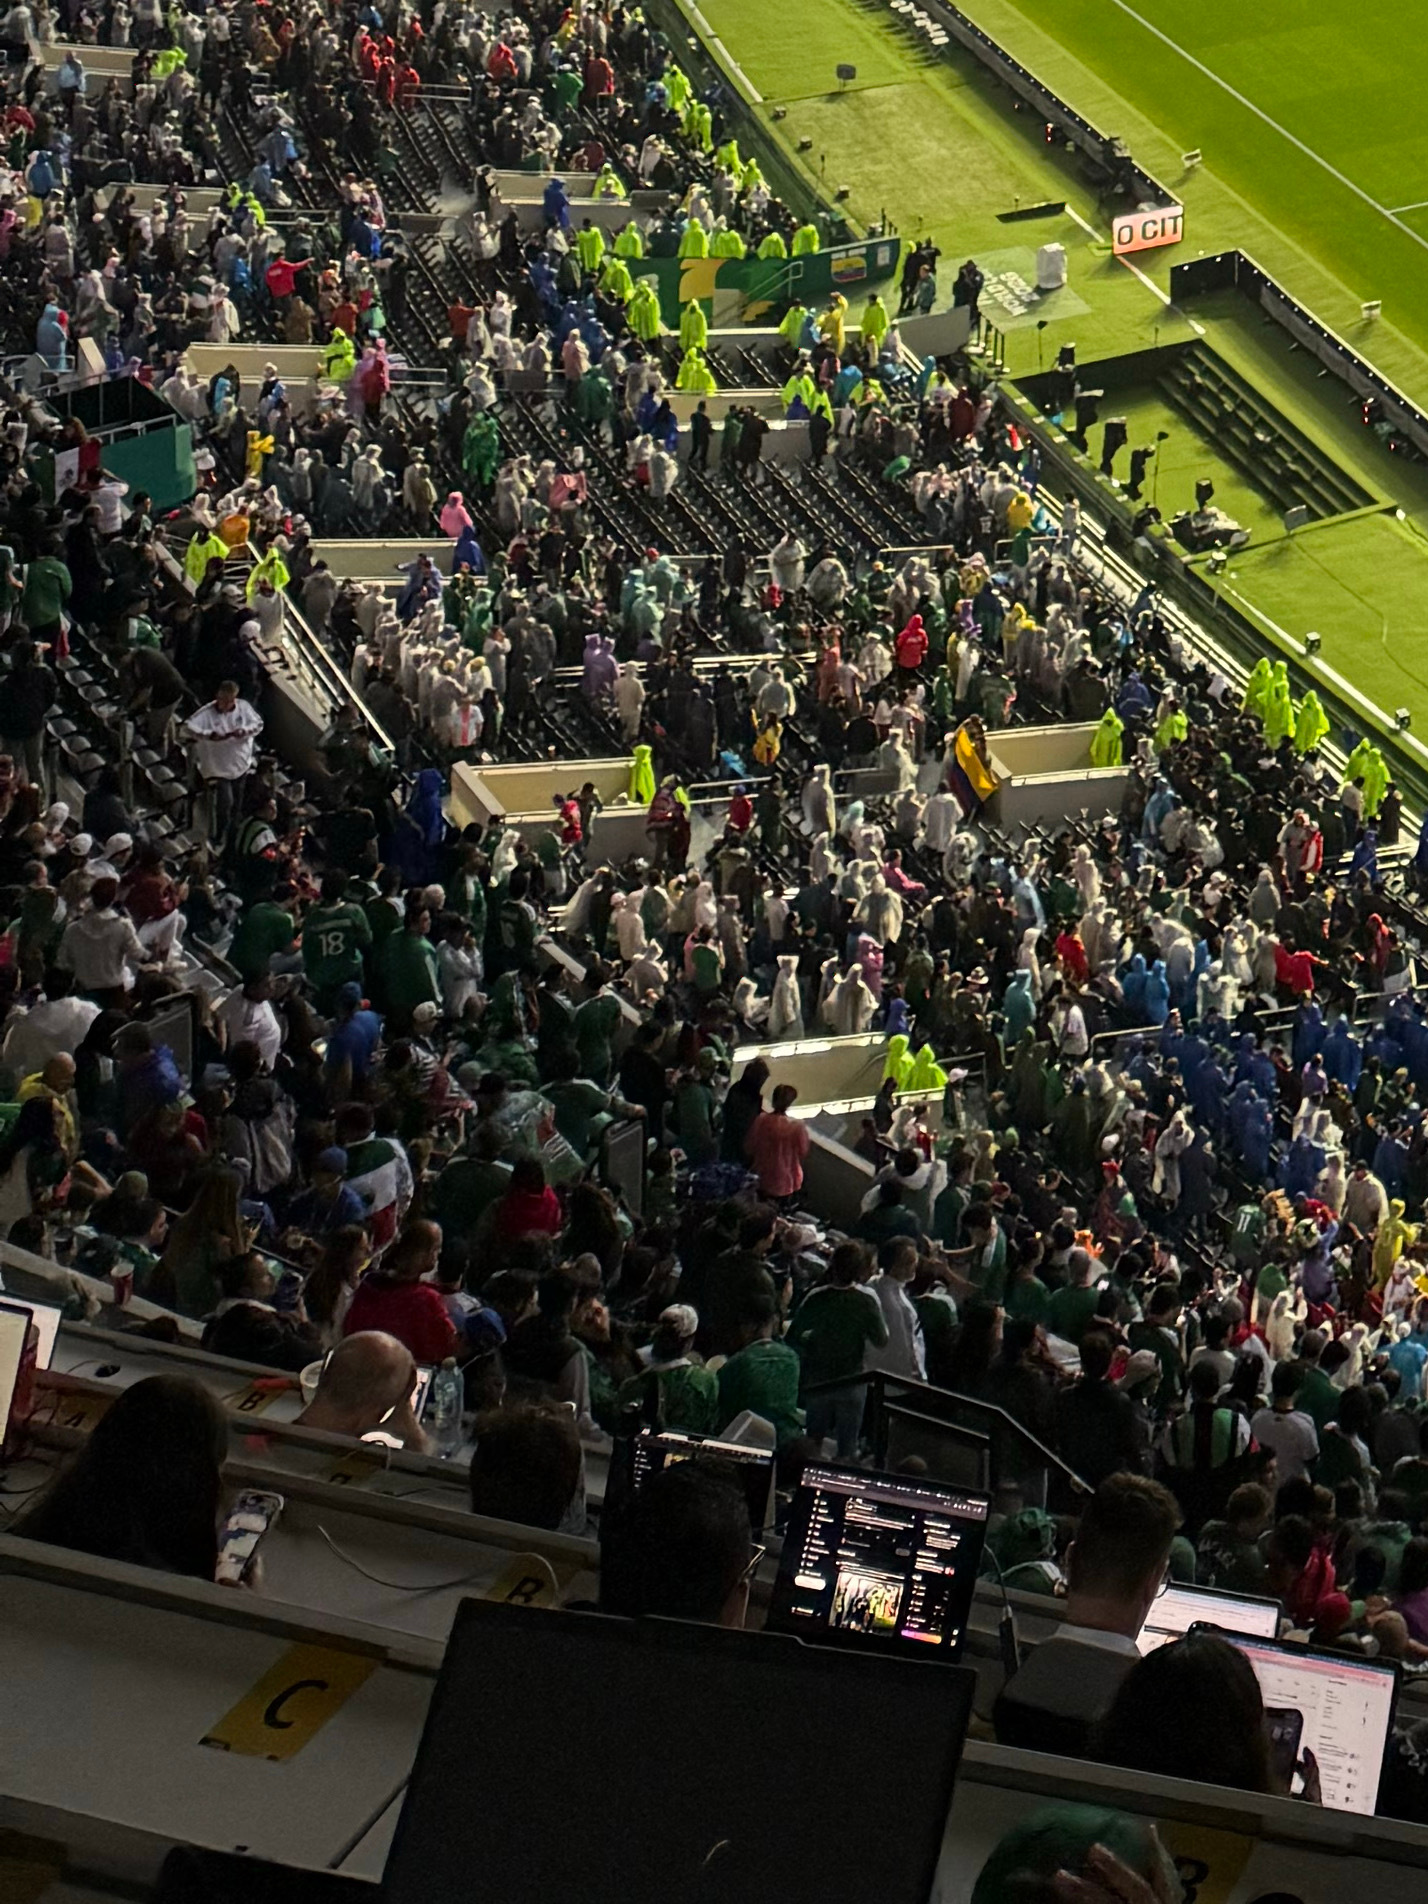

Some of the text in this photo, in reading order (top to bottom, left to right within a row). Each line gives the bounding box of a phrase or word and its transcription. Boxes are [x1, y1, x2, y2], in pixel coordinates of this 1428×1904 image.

[1117, 215, 1178, 245] O CIT
[318, 931, 345, 956] 18
[263, 1679, 329, 1730] C
